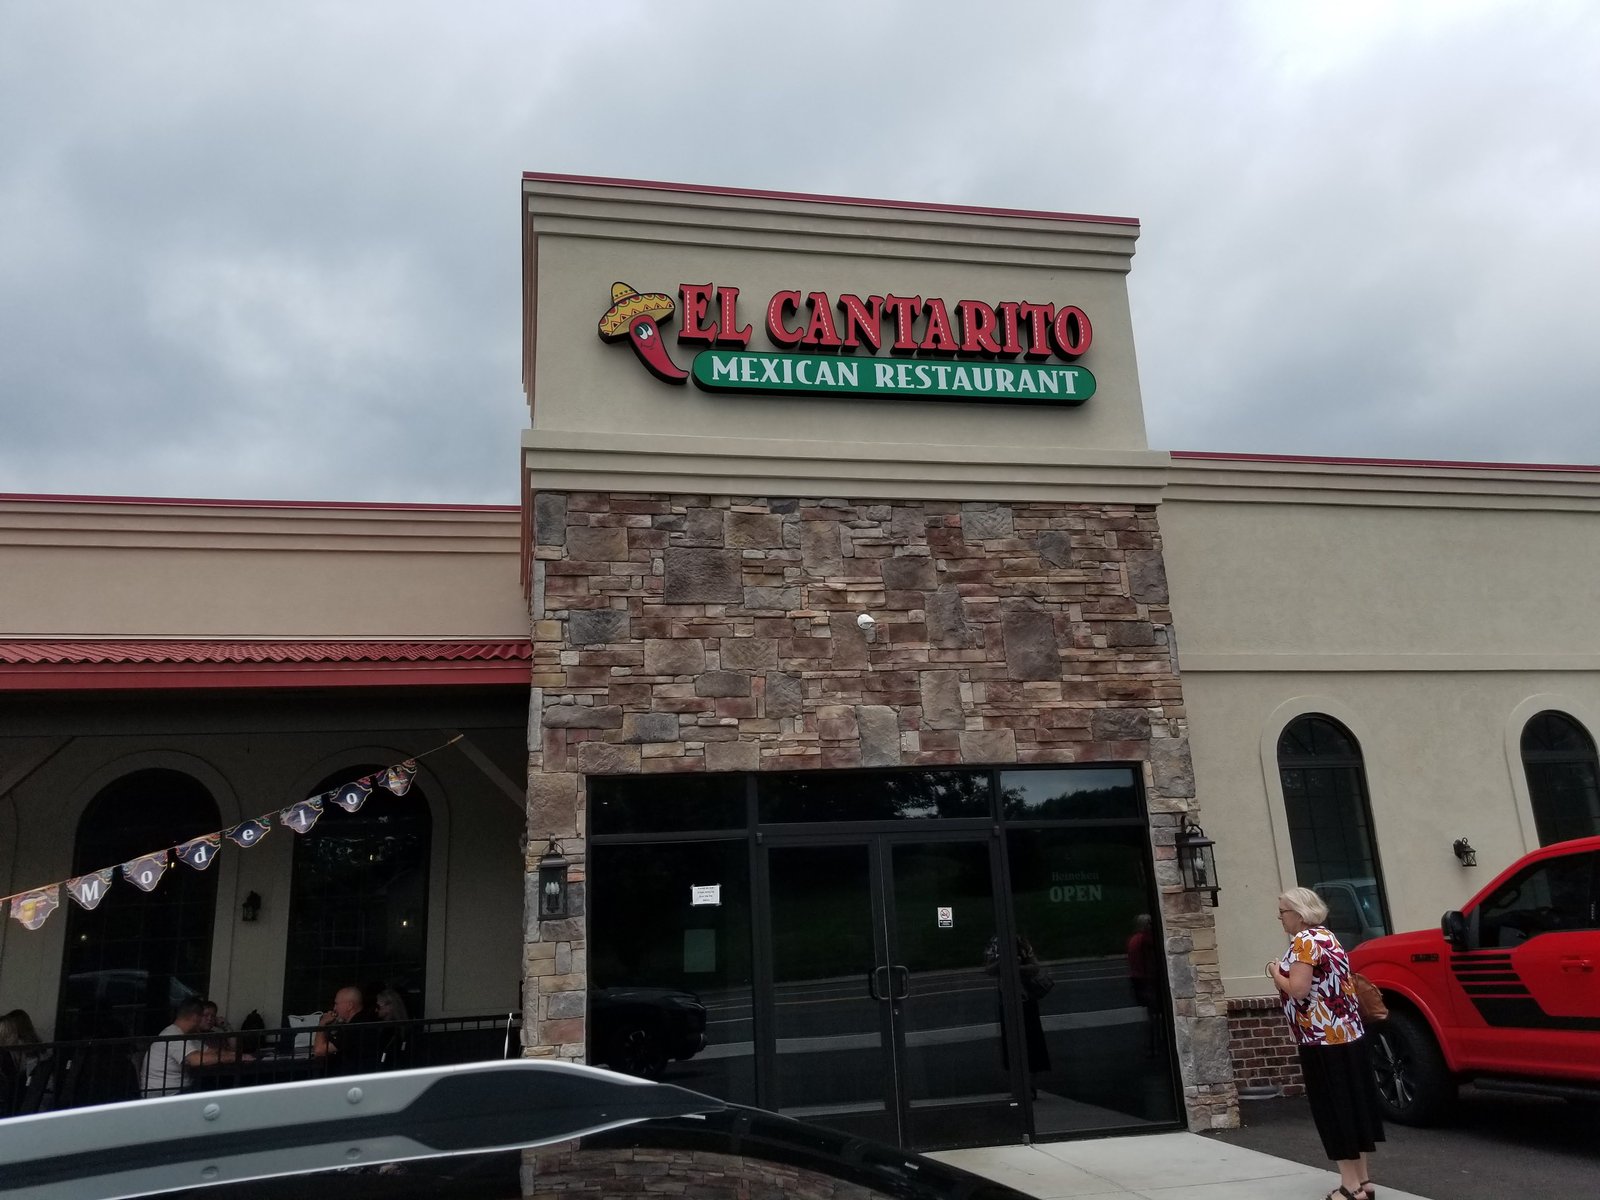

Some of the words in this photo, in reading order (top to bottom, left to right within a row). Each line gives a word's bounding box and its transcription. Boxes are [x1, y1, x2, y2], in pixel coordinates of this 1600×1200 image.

[678, 282, 753, 345] EL
[766, 291, 1093, 360] CANTARITO
[711, 355, 859, 387] MEXICAN
[875, 364, 1079, 395] RESTAURANT
[1049, 884, 1102, 902] OPEN
